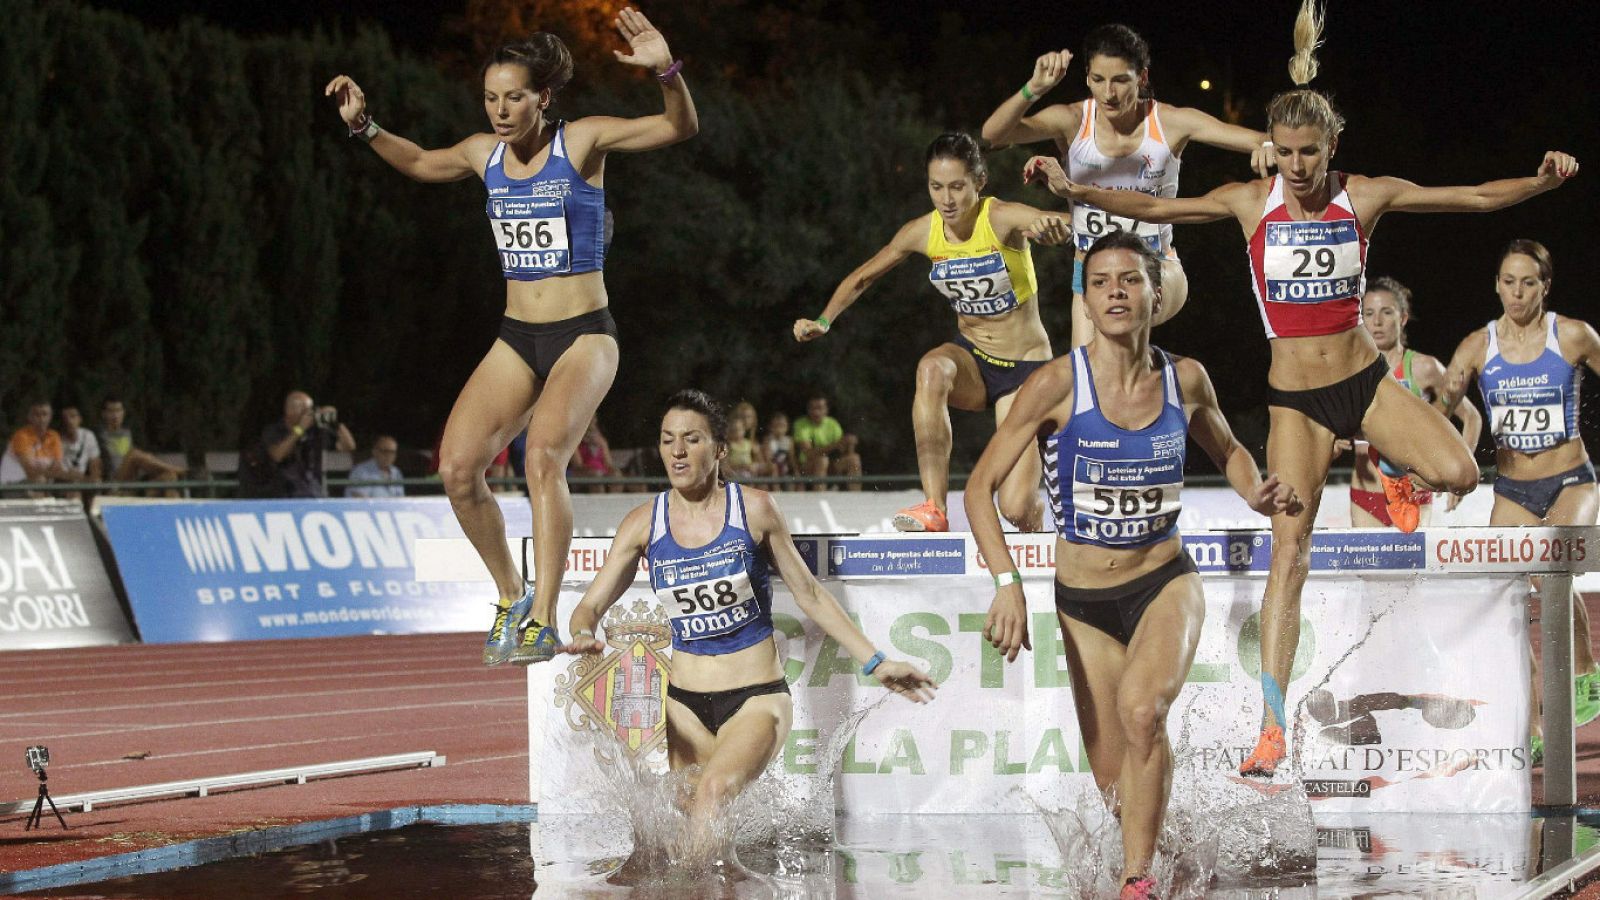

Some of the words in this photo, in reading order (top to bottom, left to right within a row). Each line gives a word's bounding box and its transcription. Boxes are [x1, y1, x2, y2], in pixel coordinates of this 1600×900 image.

[500, 221, 553, 248] 566
[1292, 247, 1335, 278] 29
[945, 278, 999, 300] 552
[1502, 408, 1551, 431] 479
[1078, 438, 1120, 449] hummel
[1093, 487, 1164, 516] 569
[887, 551, 921, 559] Apuestas
[922, 549, 935, 558] del
[936, 550, 962, 558] Estado
[1186, 542, 1253, 566] ma
[1343, 544, 1379, 553] Apuestas
[1381, 544, 1393, 552] del
[1394, 544, 1421, 552] Estado
[1436, 533, 1534, 563] CASTELLÓ
[1539, 537, 1587, 562] 2015
[196, 583, 301, 605] SPORT
[317, 581, 336, 598] &
[349, 579, 472, 597] FLOOR
[672, 580, 738, 614] 568
[784, 729, 819, 775] E
[840, 728, 926, 776] LA
[1303, 782, 1370, 794] CASTELLO
